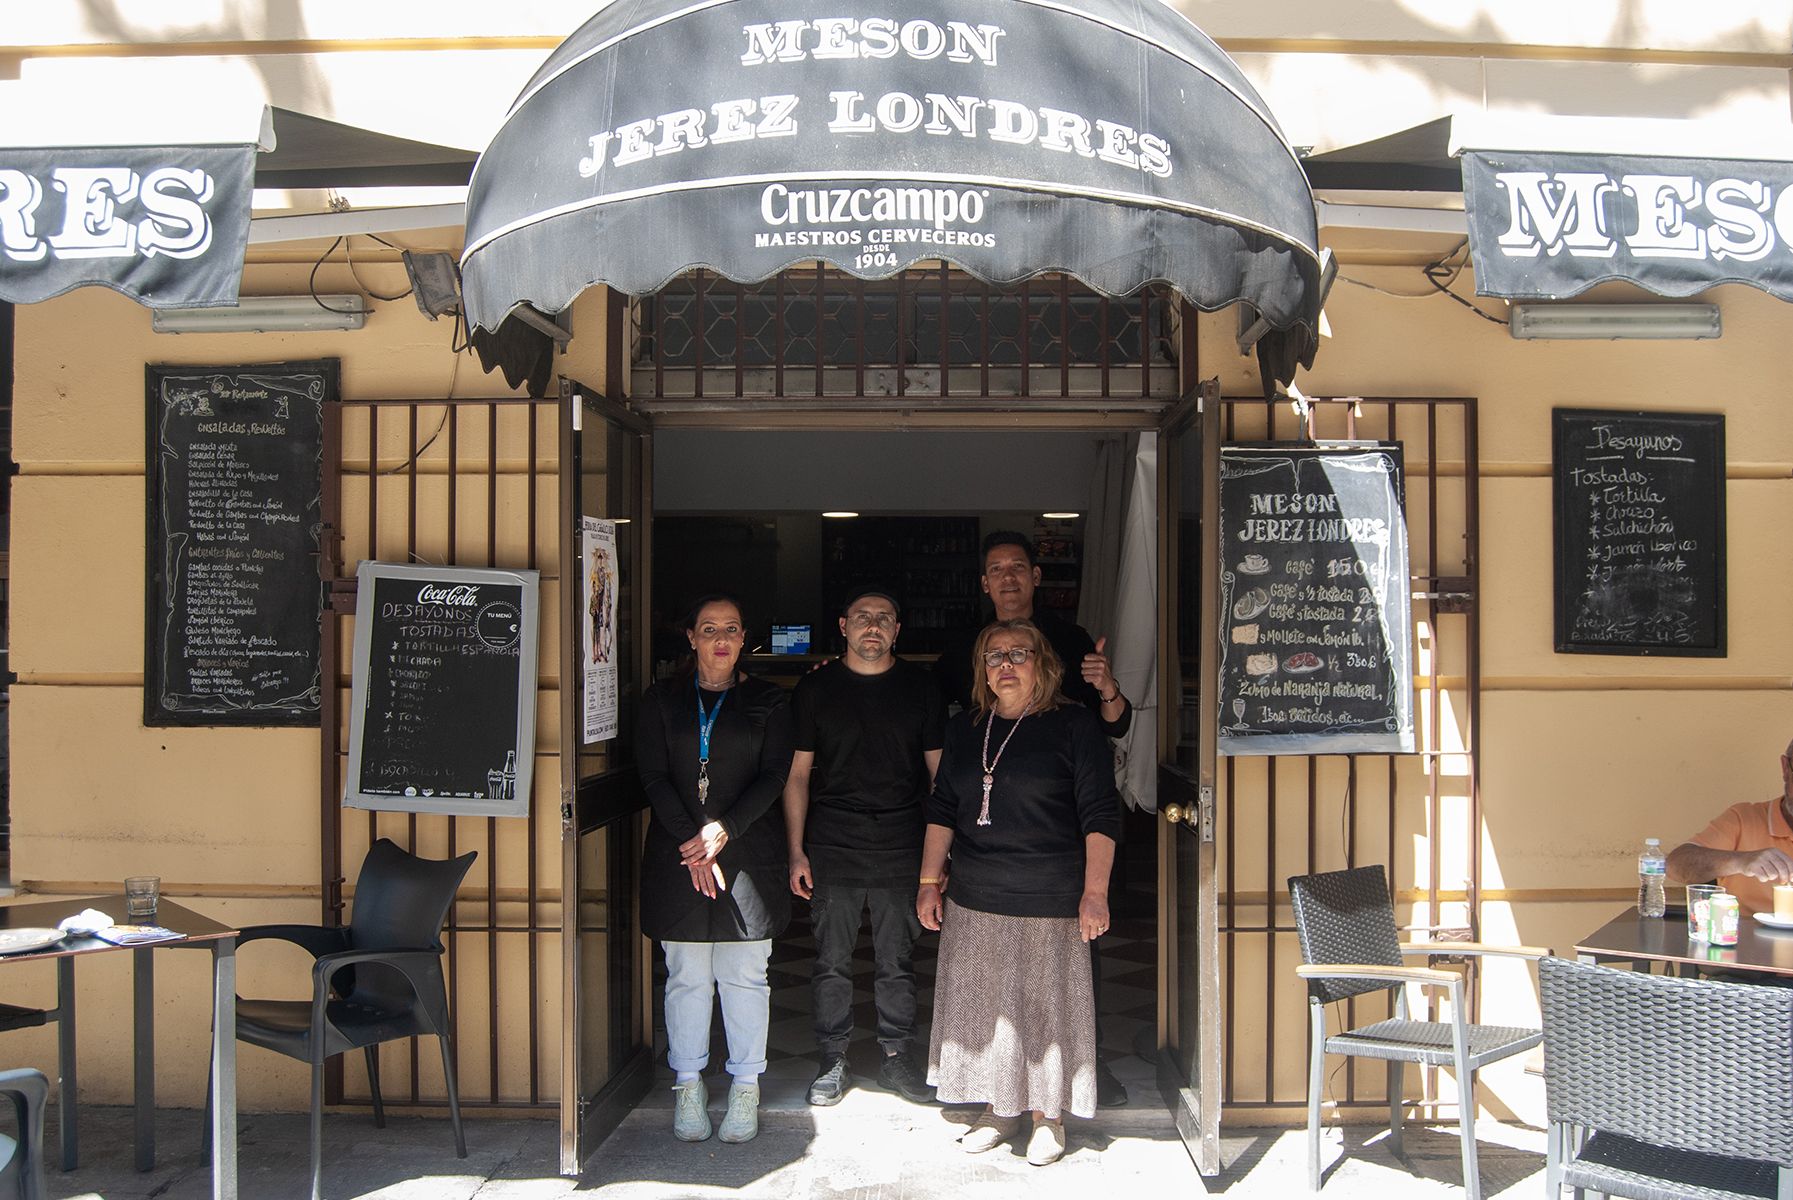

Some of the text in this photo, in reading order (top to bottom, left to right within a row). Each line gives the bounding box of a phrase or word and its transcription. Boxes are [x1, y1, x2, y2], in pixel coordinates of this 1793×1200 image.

[741, 19, 1006, 66] MESON
[578, 91, 1173, 178] JEREZ LONDRES
[760, 184, 984, 229] Cruzcampo
[755, 229, 996, 248] MAESTROS CERVECEROS
[863, 244, 890, 252] DESDE
[854, 252, 898, 268] 1904
[1585, 425, 1682, 459] Desayunos
[1250, 493, 1338, 515] MESON
[1603, 486, 1665, 504] Tortilla
[1237, 518, 1305, 543] JEREZ
[417, 583, 481, 606] Coca-Cola
[399, 626, 475, 639] TOSTADAS
[1271, 681, 1281, 696] de
